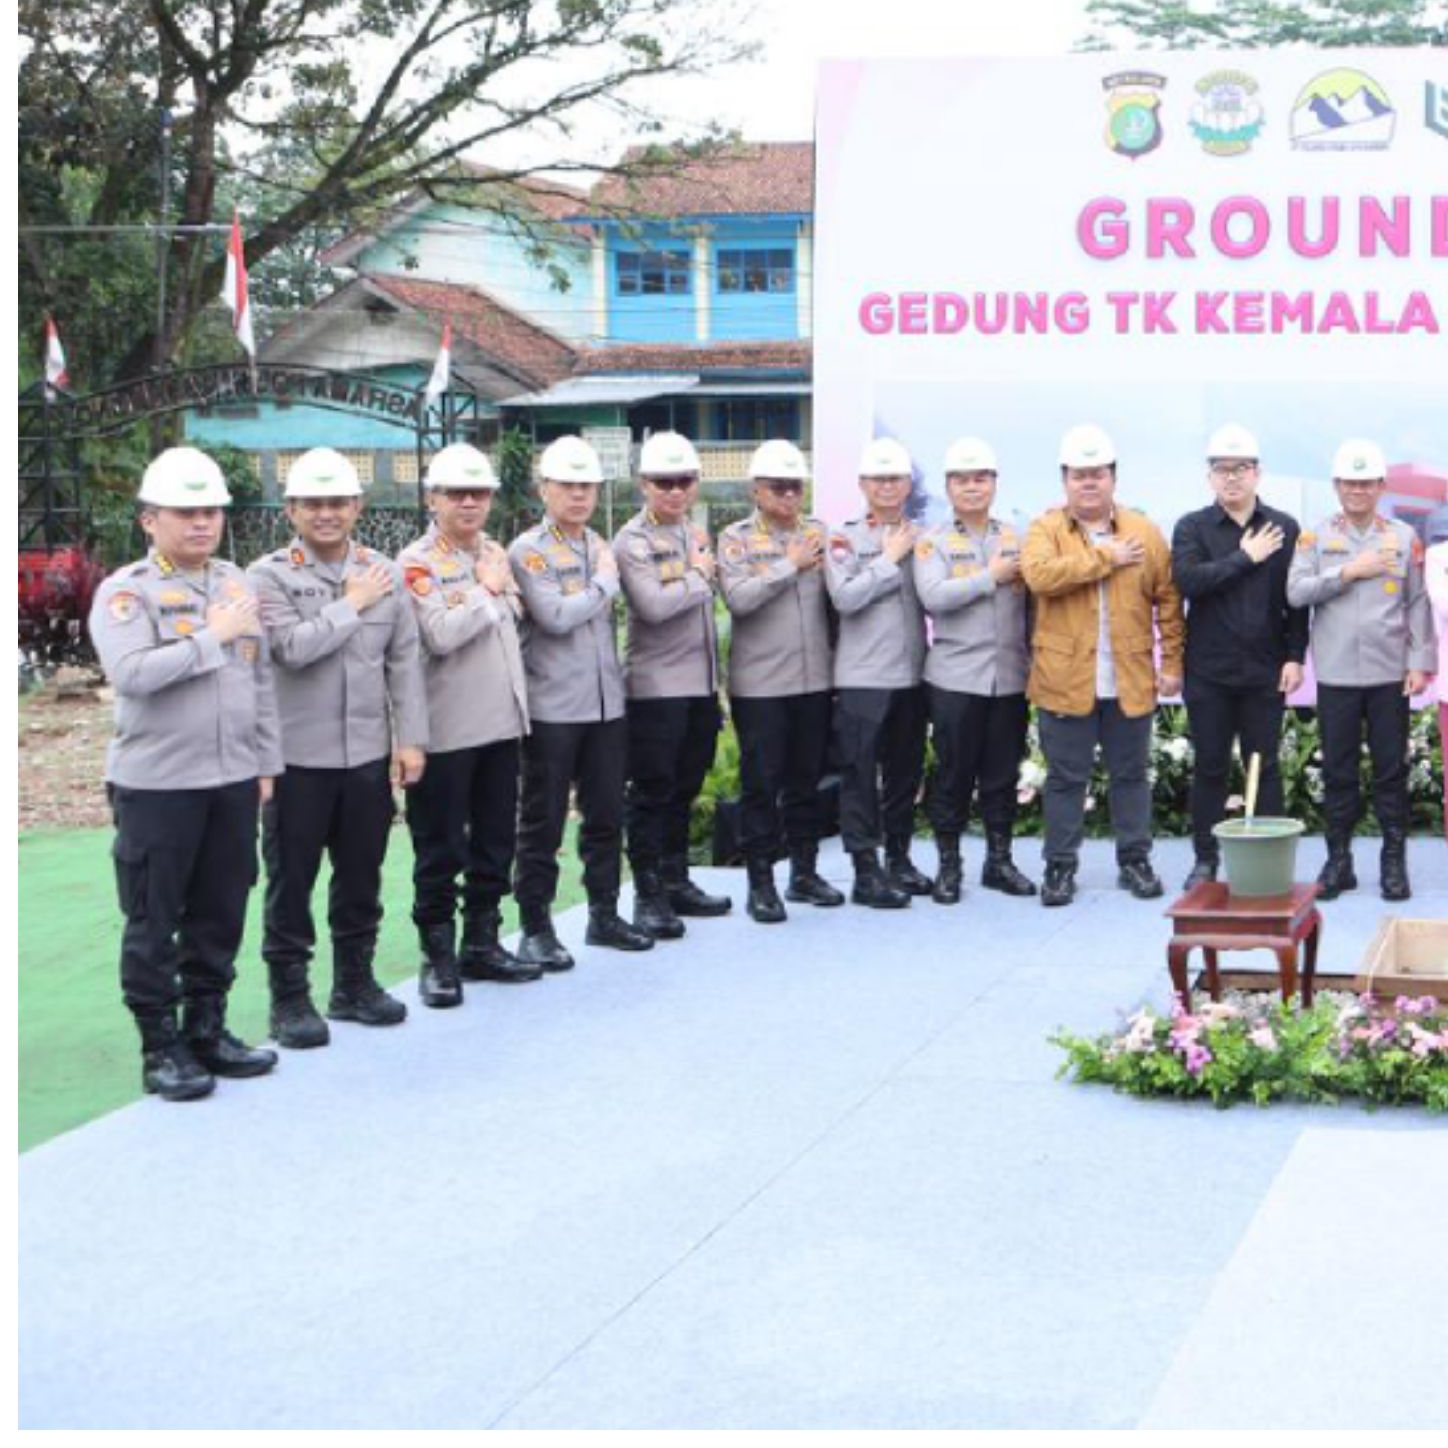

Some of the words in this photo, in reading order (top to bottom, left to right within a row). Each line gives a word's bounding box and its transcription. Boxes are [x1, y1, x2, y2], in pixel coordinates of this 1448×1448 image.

[858, 292, 1091, 336] GEDUNG
[1106, 292, 1177, 335] TK
[1194, 291, 1440, 335] KEMALA
